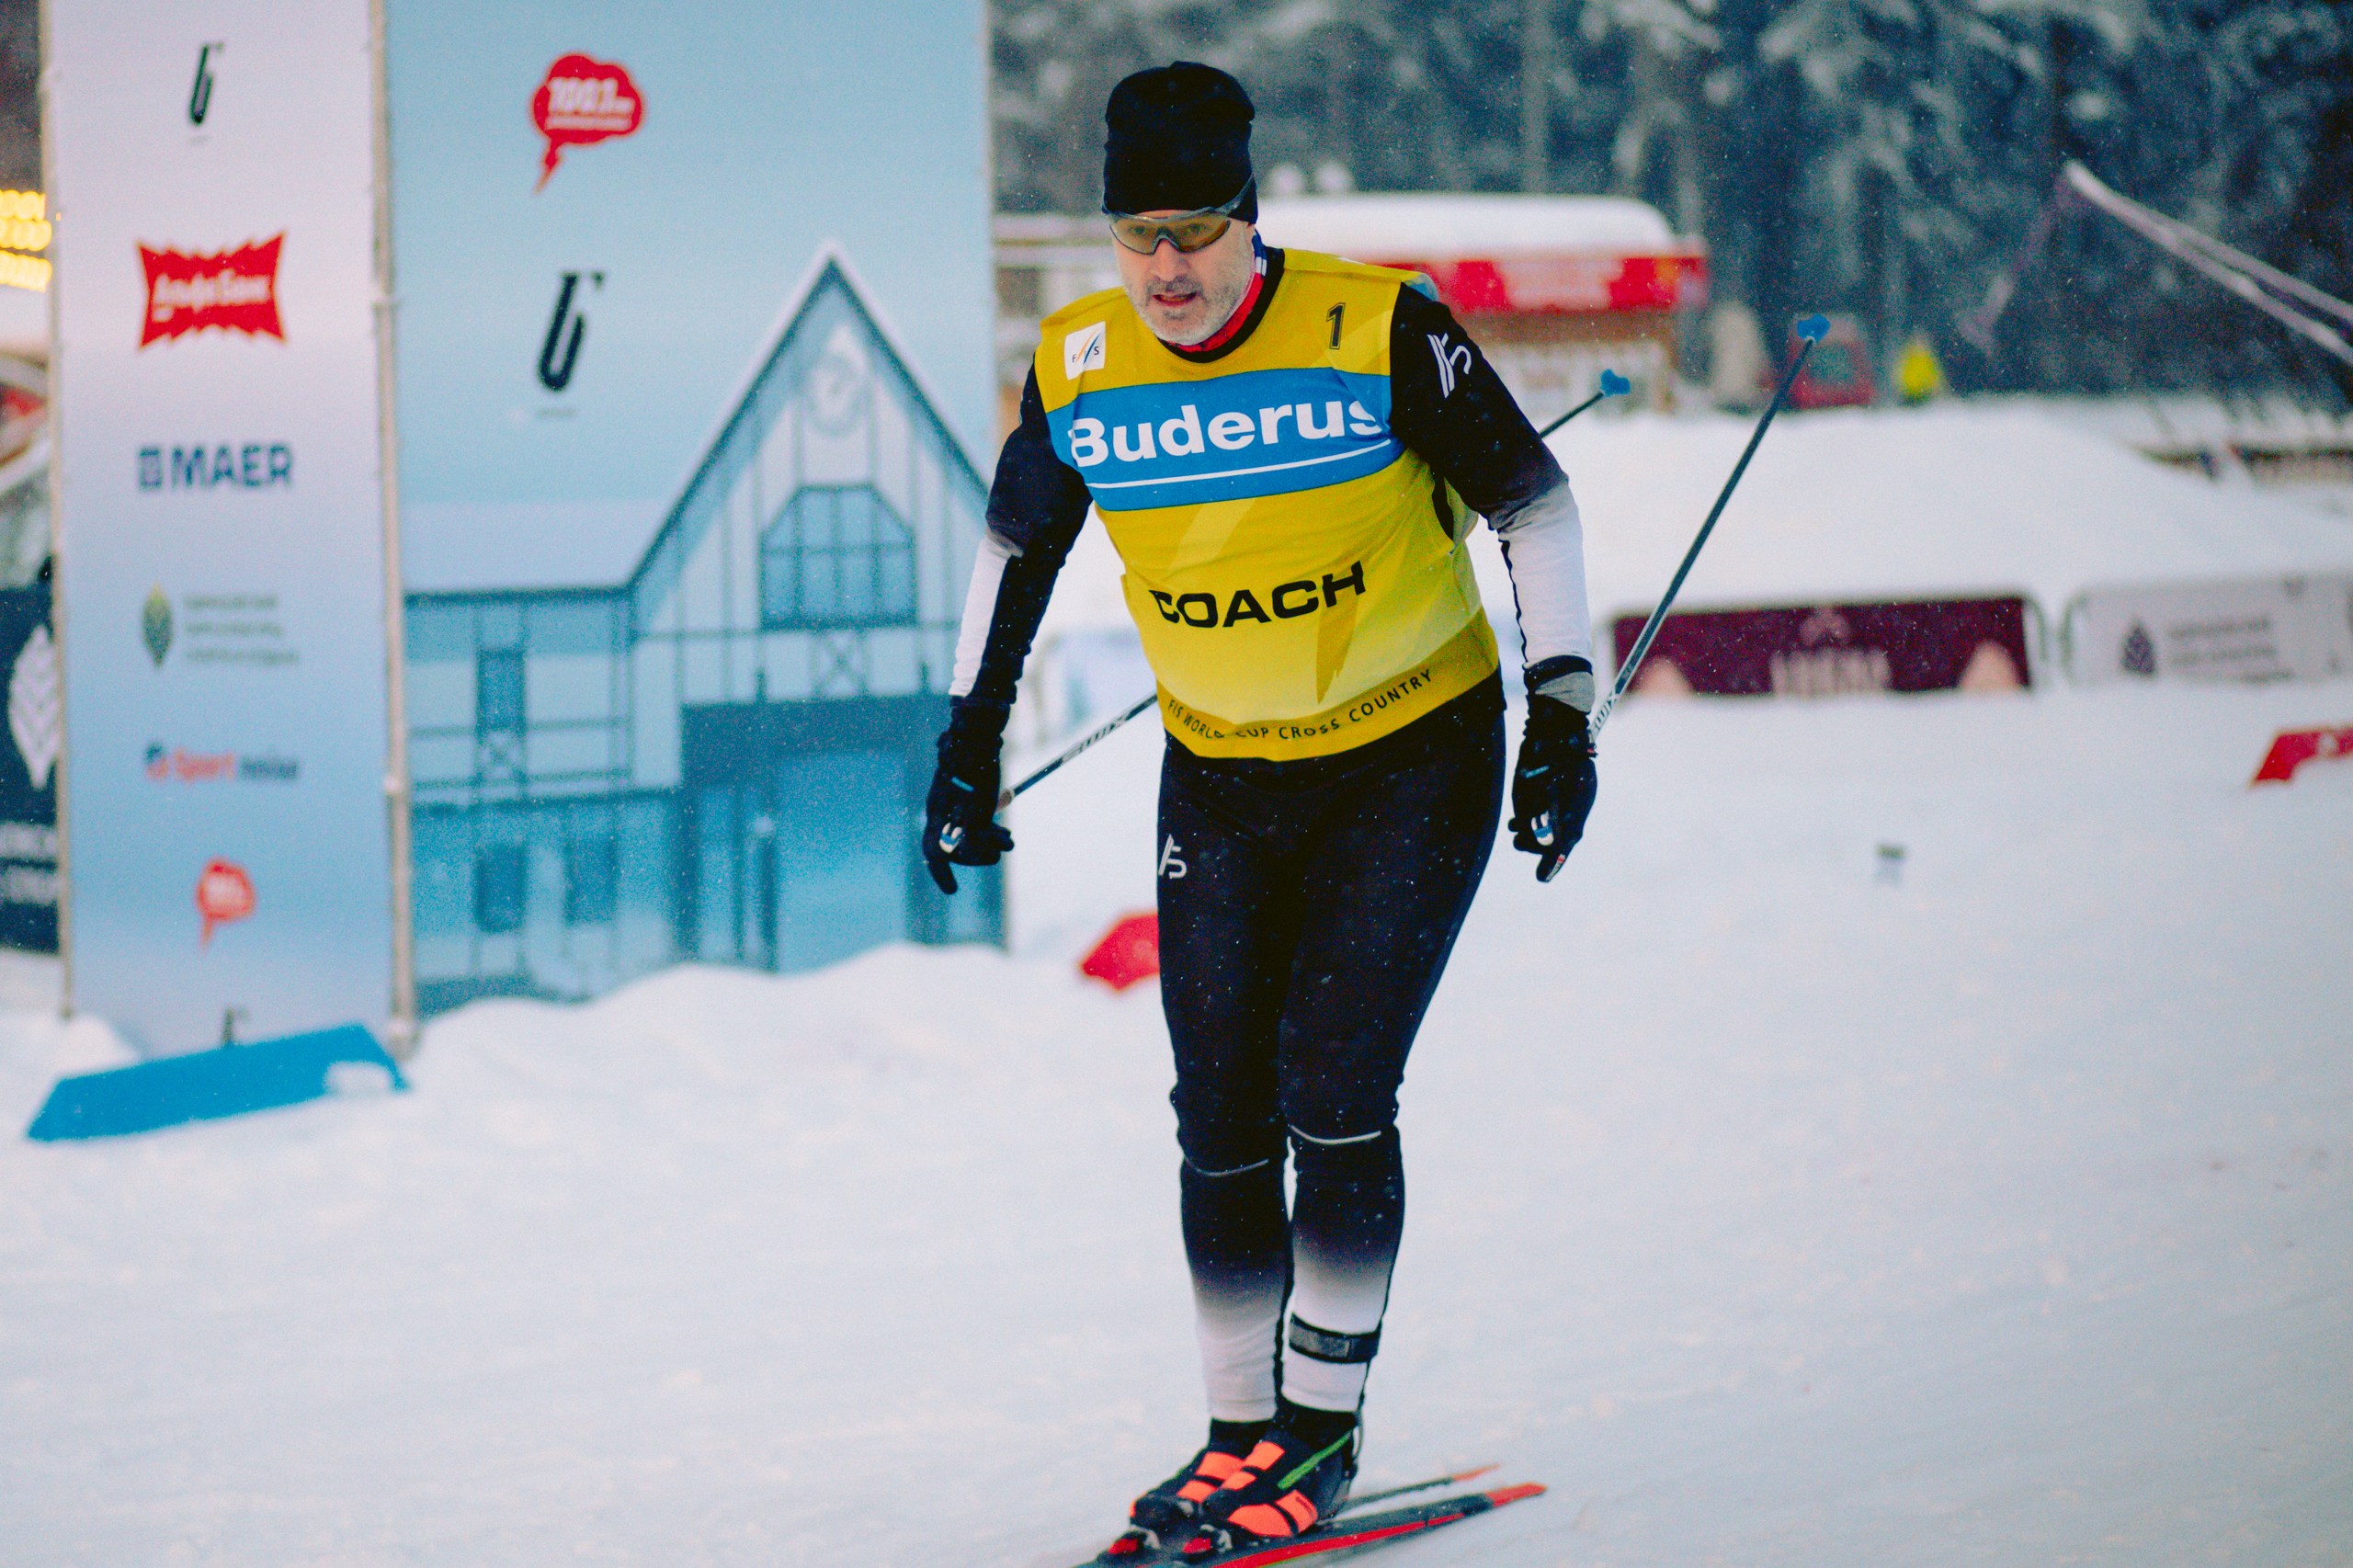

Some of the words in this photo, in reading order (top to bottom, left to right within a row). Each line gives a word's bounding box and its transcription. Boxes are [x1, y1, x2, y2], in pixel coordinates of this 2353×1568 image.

[1325, 302, 1347, 350] 1
[171, 444, 293, 489] MAER
[1068, 400, 1382, 468] Buderus
[1148, 560, 1367, 628] COACH
[1168, 699, 1183, 718] FIS
[1184, 712, 1225, 740] WORLD
[1278, 718, 1341, 741] CROSS
[1347, 668, 1432, 723] COUNTRY
